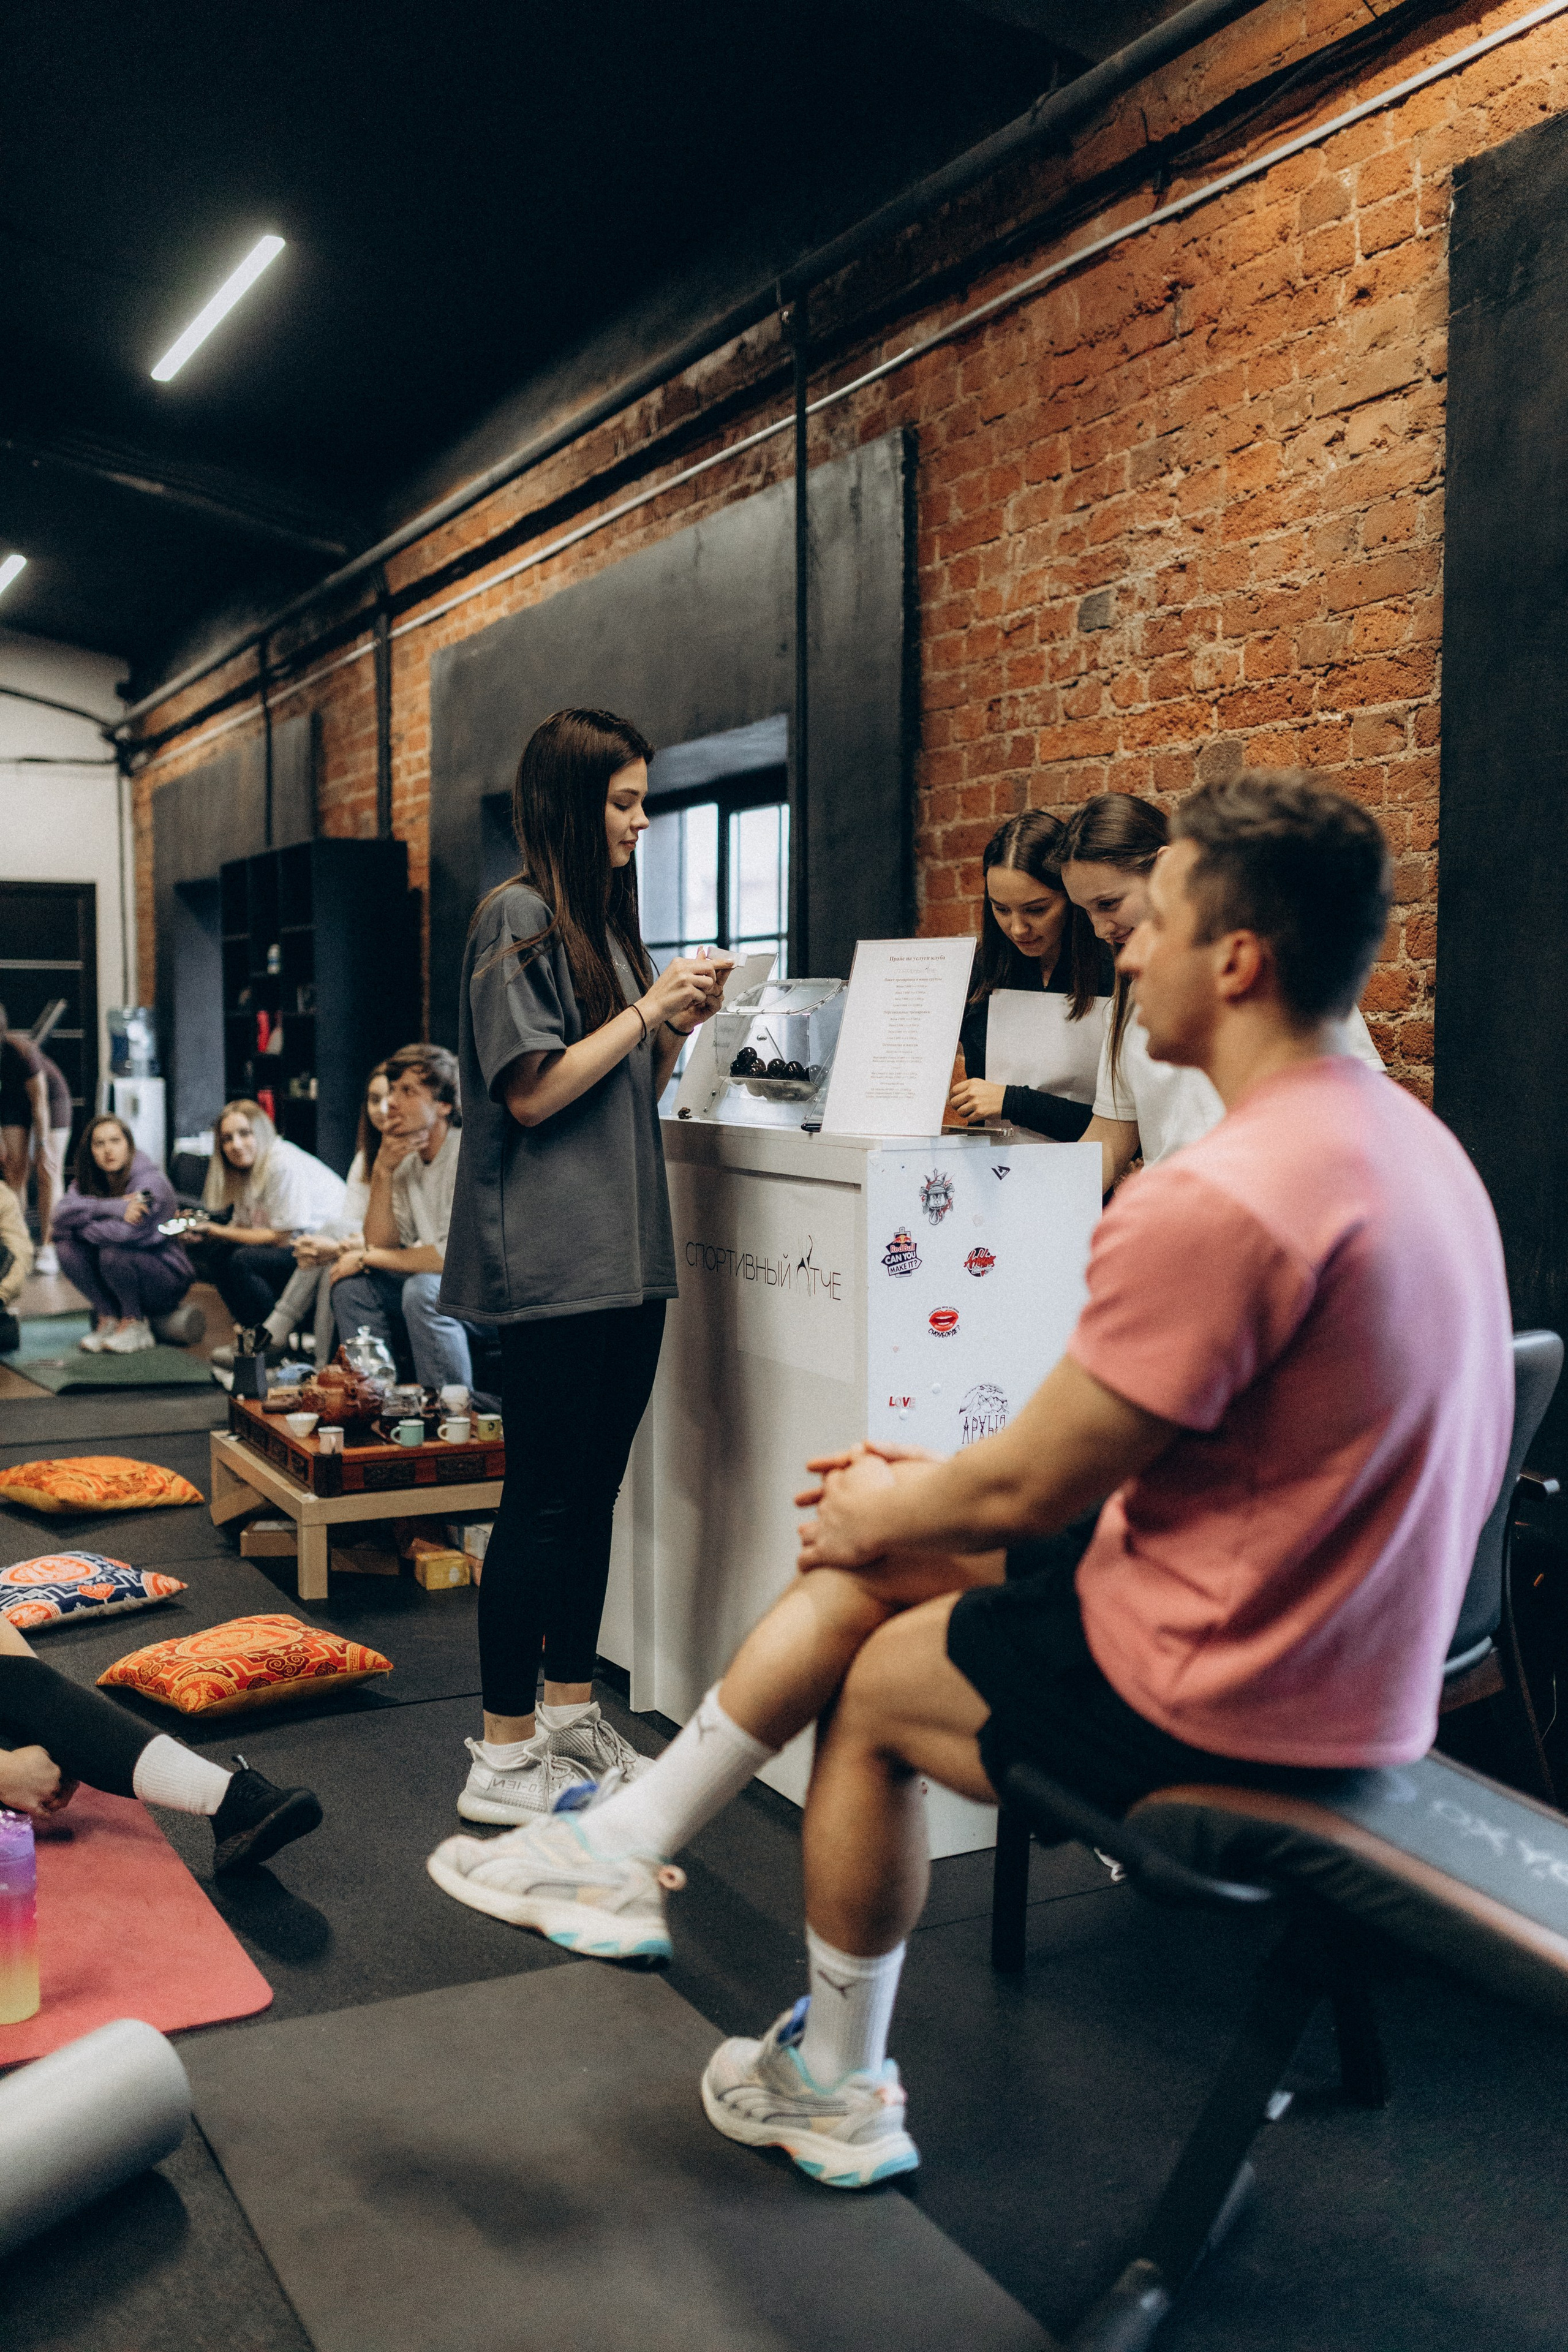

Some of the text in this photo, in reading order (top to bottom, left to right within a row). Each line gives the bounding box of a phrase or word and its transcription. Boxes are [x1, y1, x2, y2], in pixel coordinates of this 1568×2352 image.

[890, 1243, 916, 1253] Red Bull
[884, 1251, 916, 1265] CAN YOU
[685, 1242, 791, 1289] СПОРТИВНЫЙ
[890, 1259, 918, 1274] MAKE IT?
[928, 1324, 960, 1338] СНОУБОРДЕ?
[889, 1396, 916, 1408] LOVE
